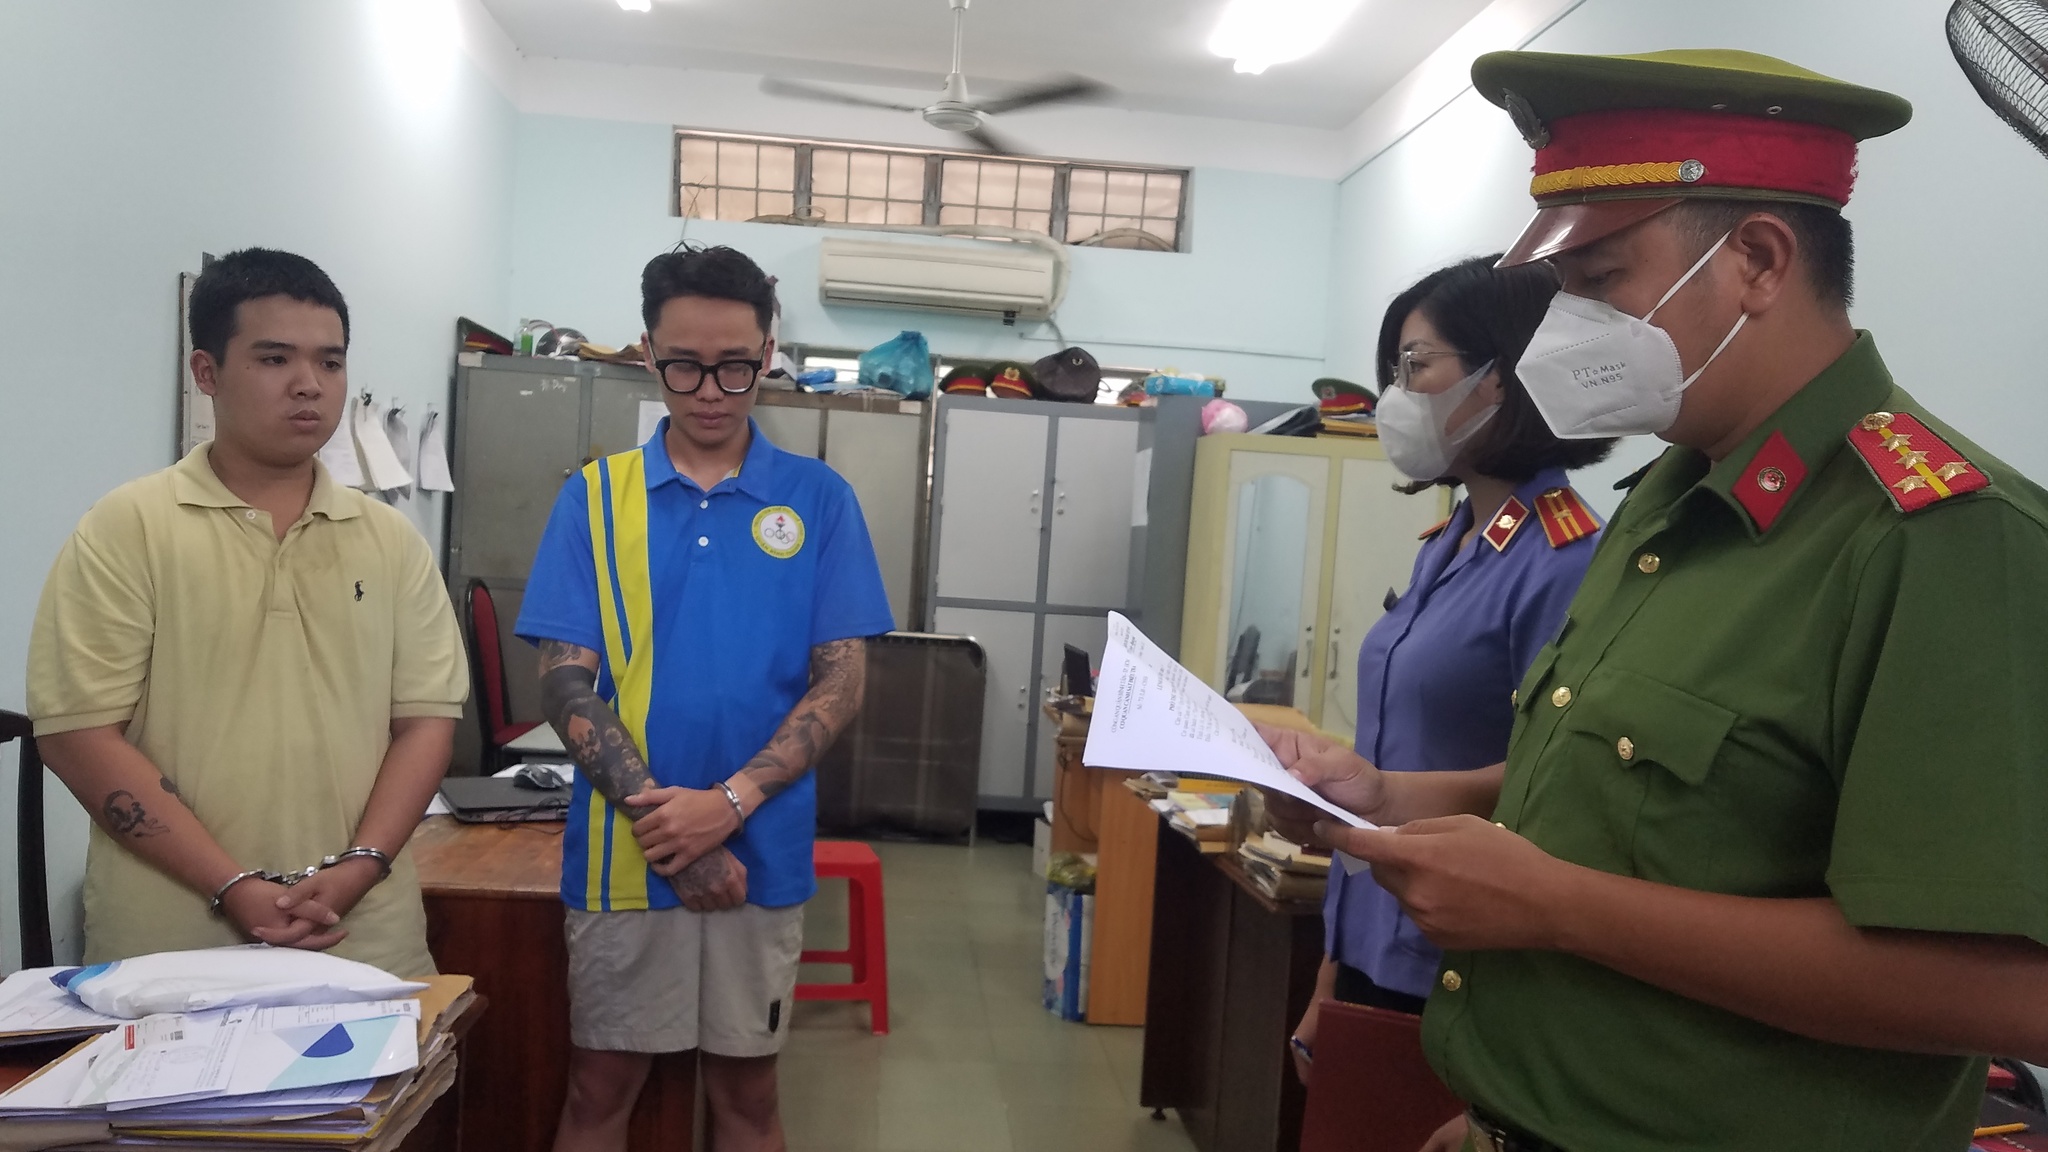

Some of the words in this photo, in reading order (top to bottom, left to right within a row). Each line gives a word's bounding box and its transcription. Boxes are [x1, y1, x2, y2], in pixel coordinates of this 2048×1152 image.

[1571, 367, 1590, 380] PT
[1600, 361, 1626, 373] Mask
[1581, 373, 1623, 389] VN.N95
